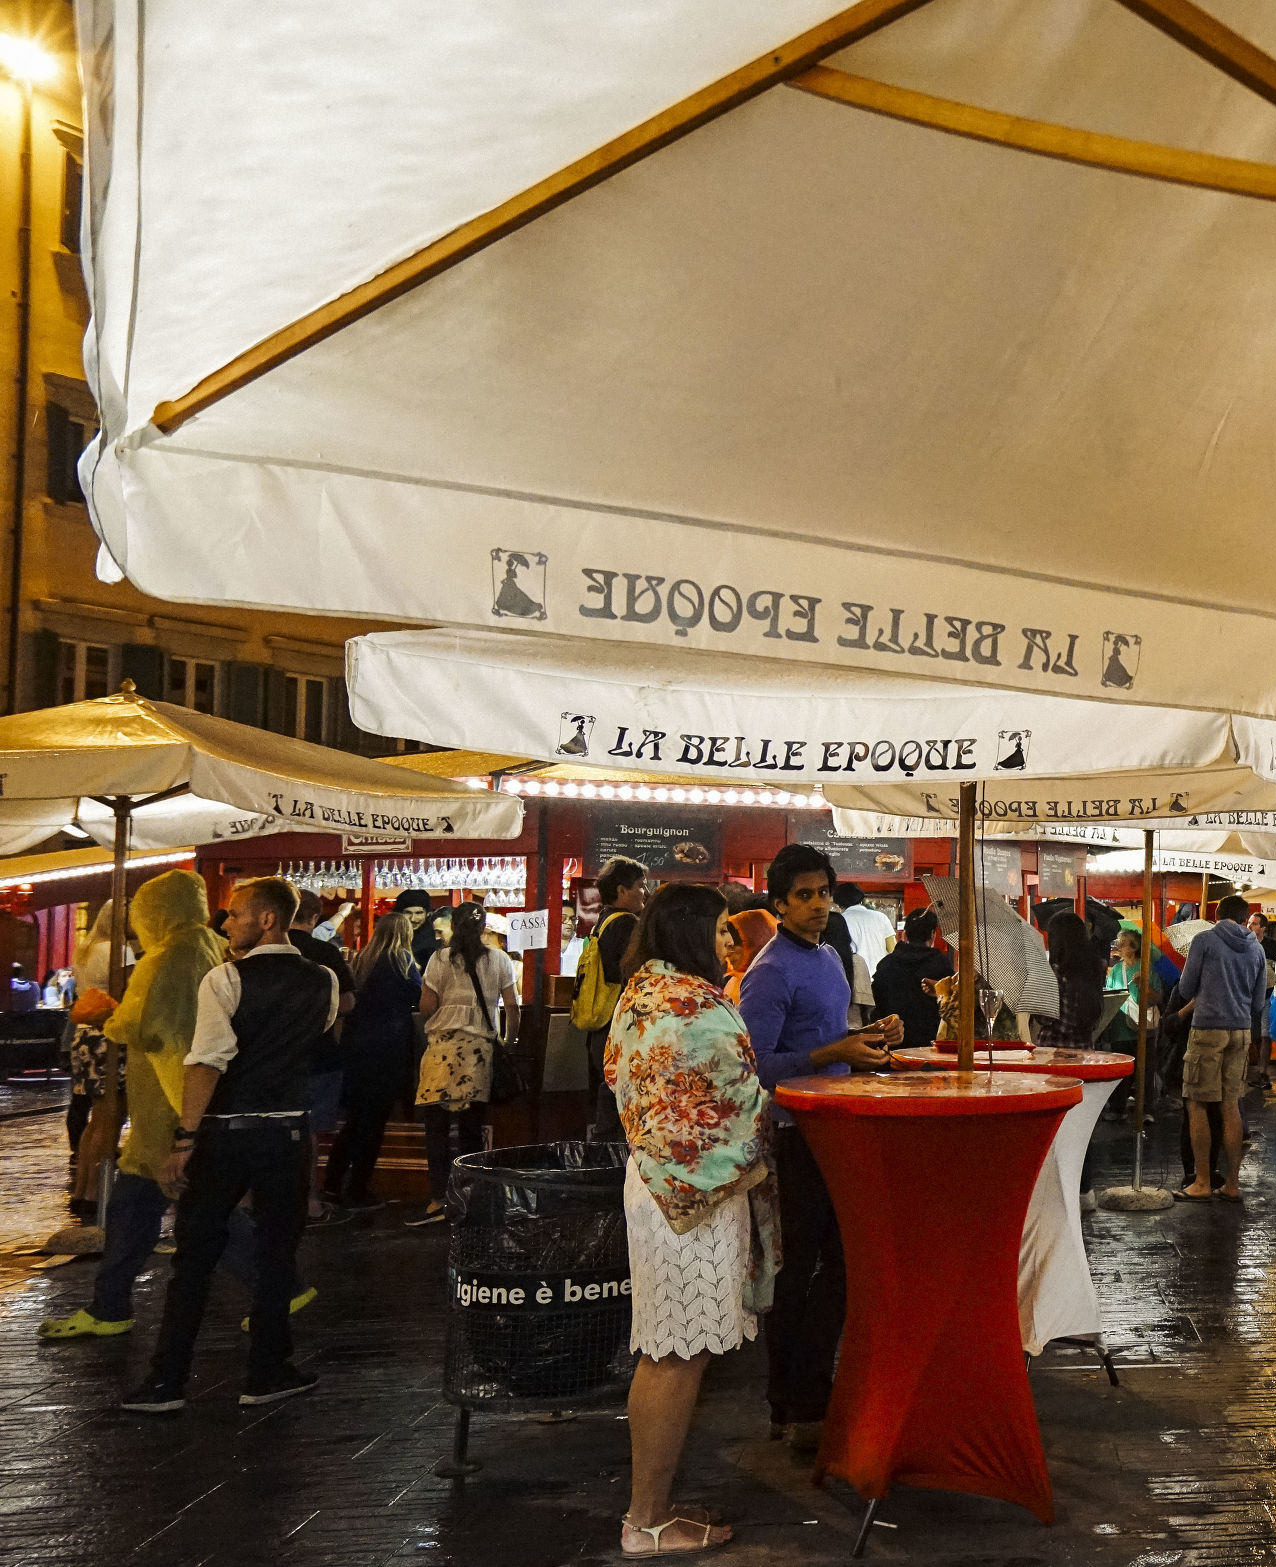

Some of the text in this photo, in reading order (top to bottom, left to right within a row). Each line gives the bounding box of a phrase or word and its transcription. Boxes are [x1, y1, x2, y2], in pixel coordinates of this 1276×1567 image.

[607, 726, 978, 777] LA BELLE EPOQUE
[290, 799, 434, 835] LA BELLE EPOQUE
[1205, 812, 1223, 825] LA
[1227, 811, 1269, 826] BELLE
[1162, 856, 1254, 873] LA BELLE EPOQUE
[510, 916, 546, 931] CASSA
[456, 1276, 526, 1307] igiene
[535, 1281, 553, 1304] è
